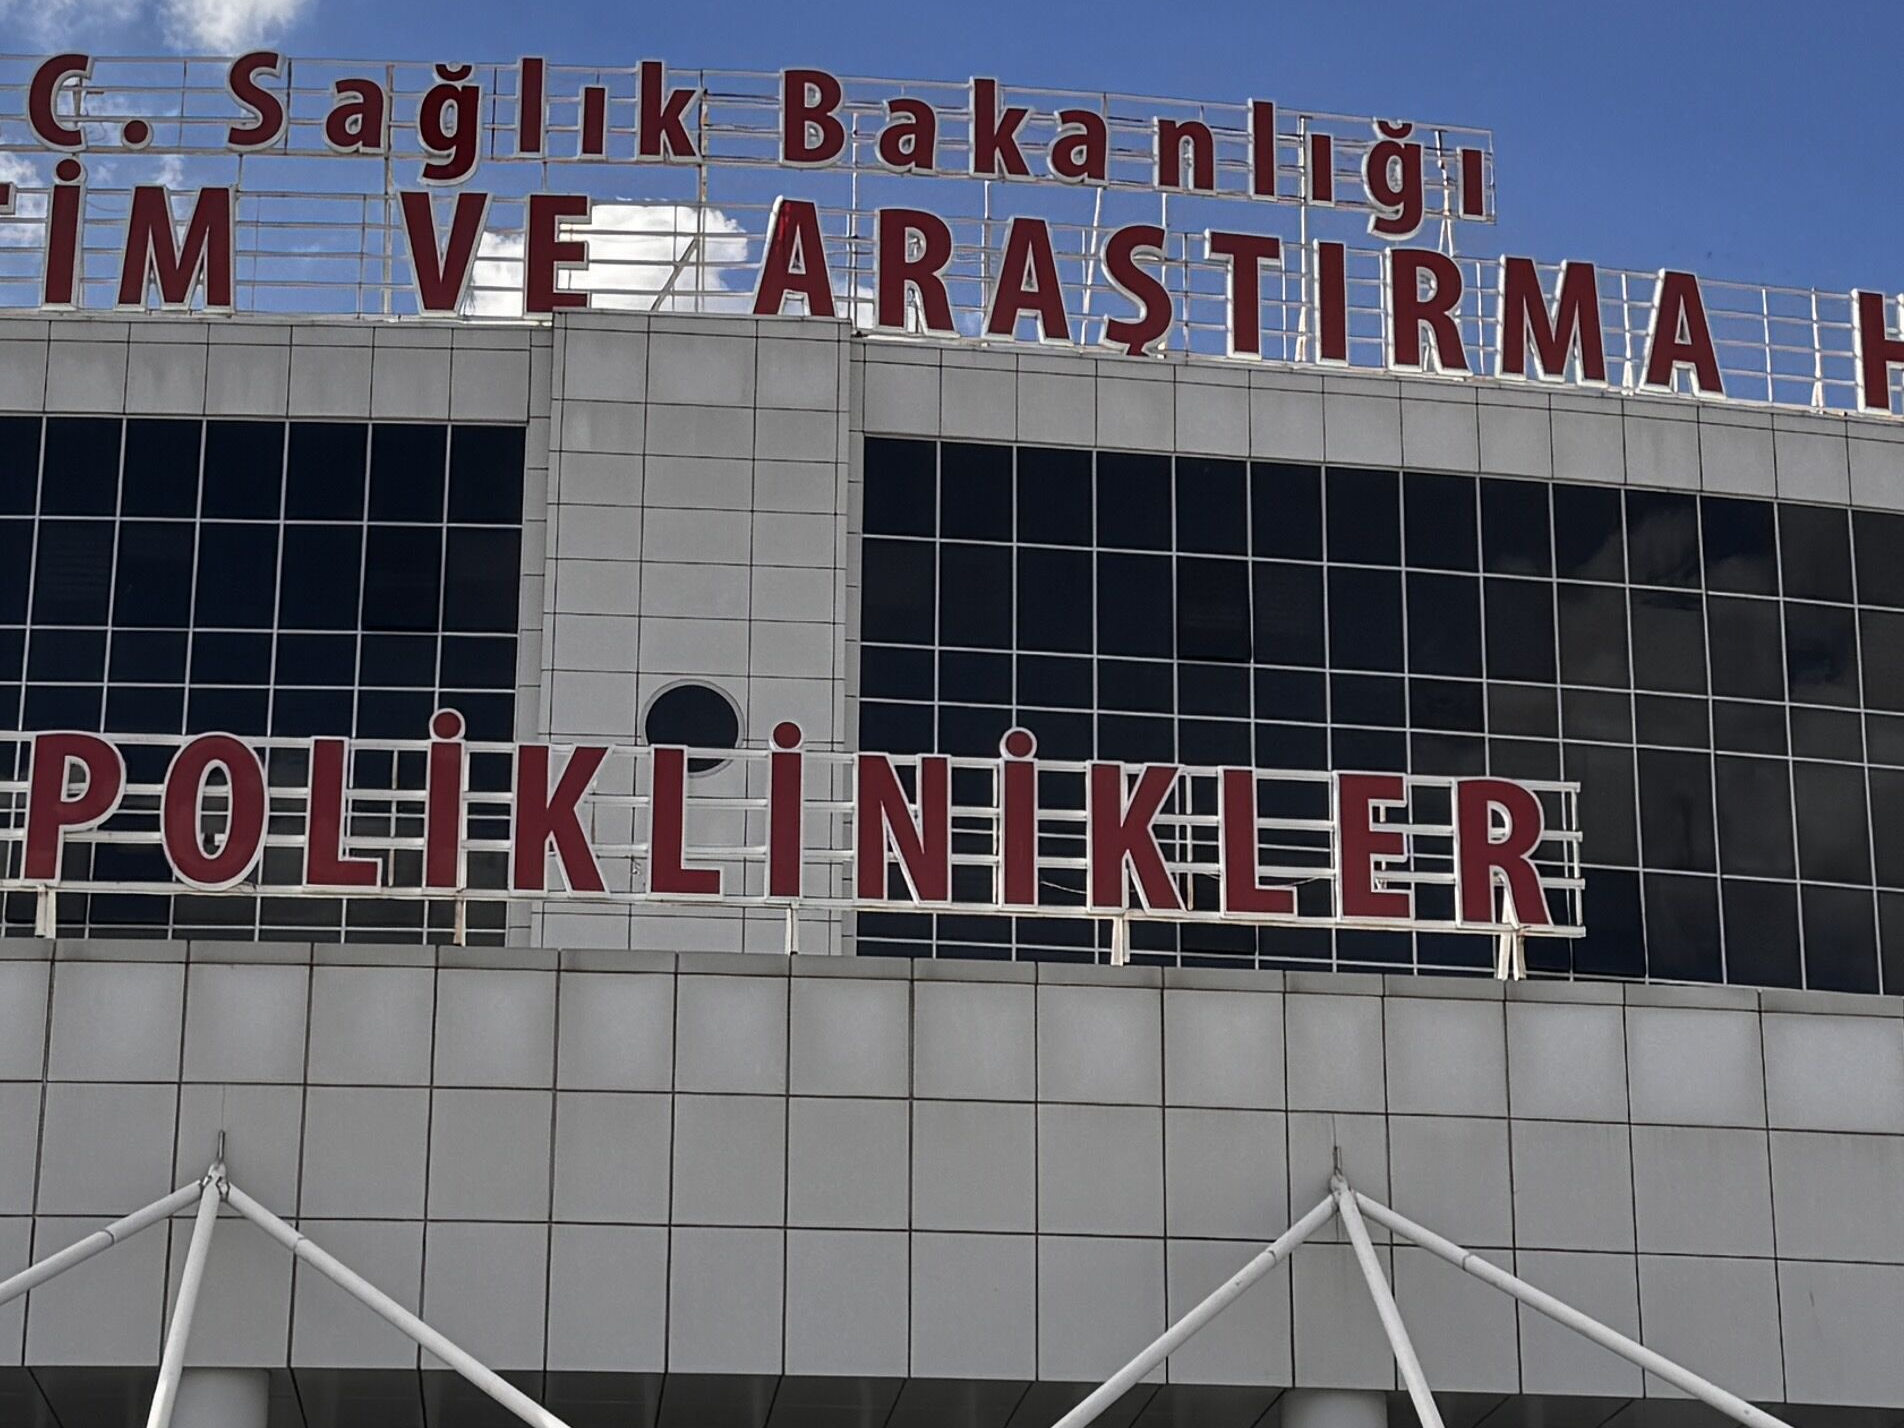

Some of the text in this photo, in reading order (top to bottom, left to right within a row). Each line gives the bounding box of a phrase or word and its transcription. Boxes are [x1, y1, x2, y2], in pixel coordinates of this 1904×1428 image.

[226, 51, 697, 186] Sağlık
[779, 68, 1494, 238] Bakanlığı
[398, 189, 593, 318] VE
[751, 196, 1727, 396] ARAŞTIRMA
[18, 706, 1553, 927] POLİKLİNİKLER
